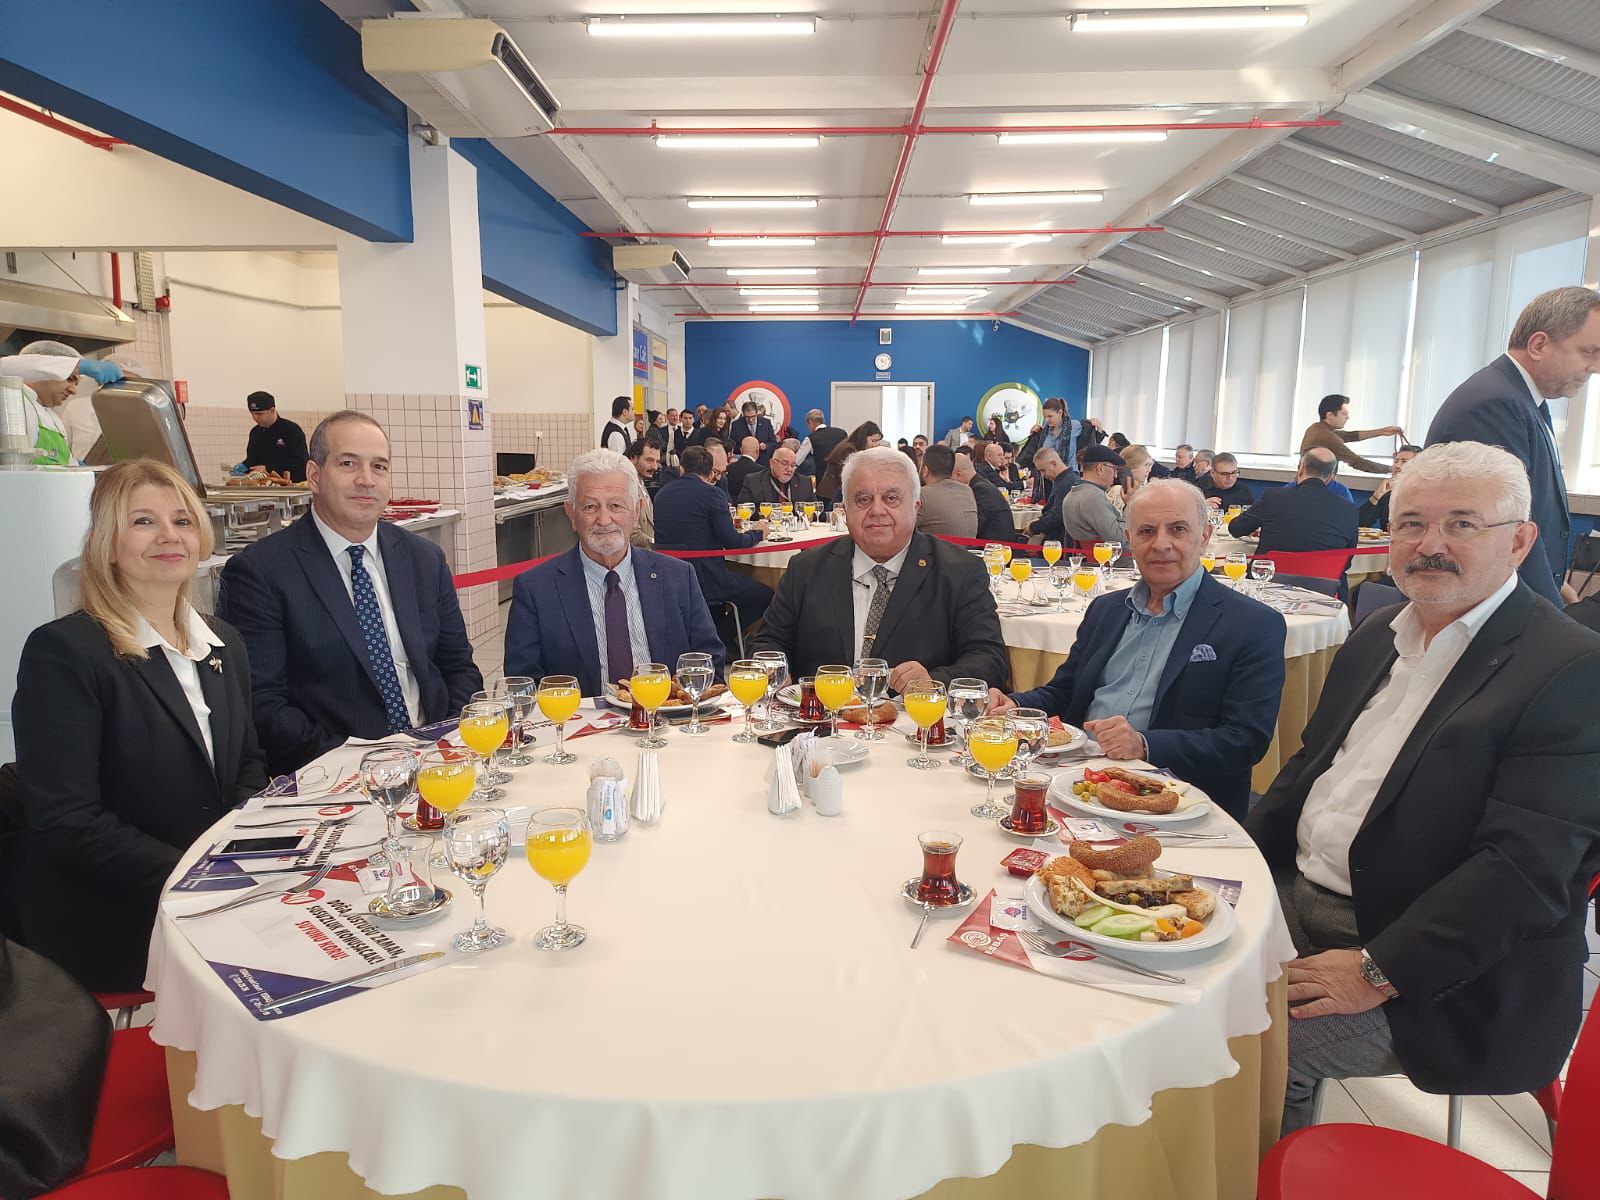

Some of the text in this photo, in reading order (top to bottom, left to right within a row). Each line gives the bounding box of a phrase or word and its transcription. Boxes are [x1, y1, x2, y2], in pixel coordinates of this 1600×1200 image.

[294, 920, 350, 961] SUYUNU KORU!
[306, 905, 386, 965] SUSUZLUK KONUŞACAK!
[346, 913, 380, 936] USTUĞU
[370, 934, 406, 959] ZAMAN,
